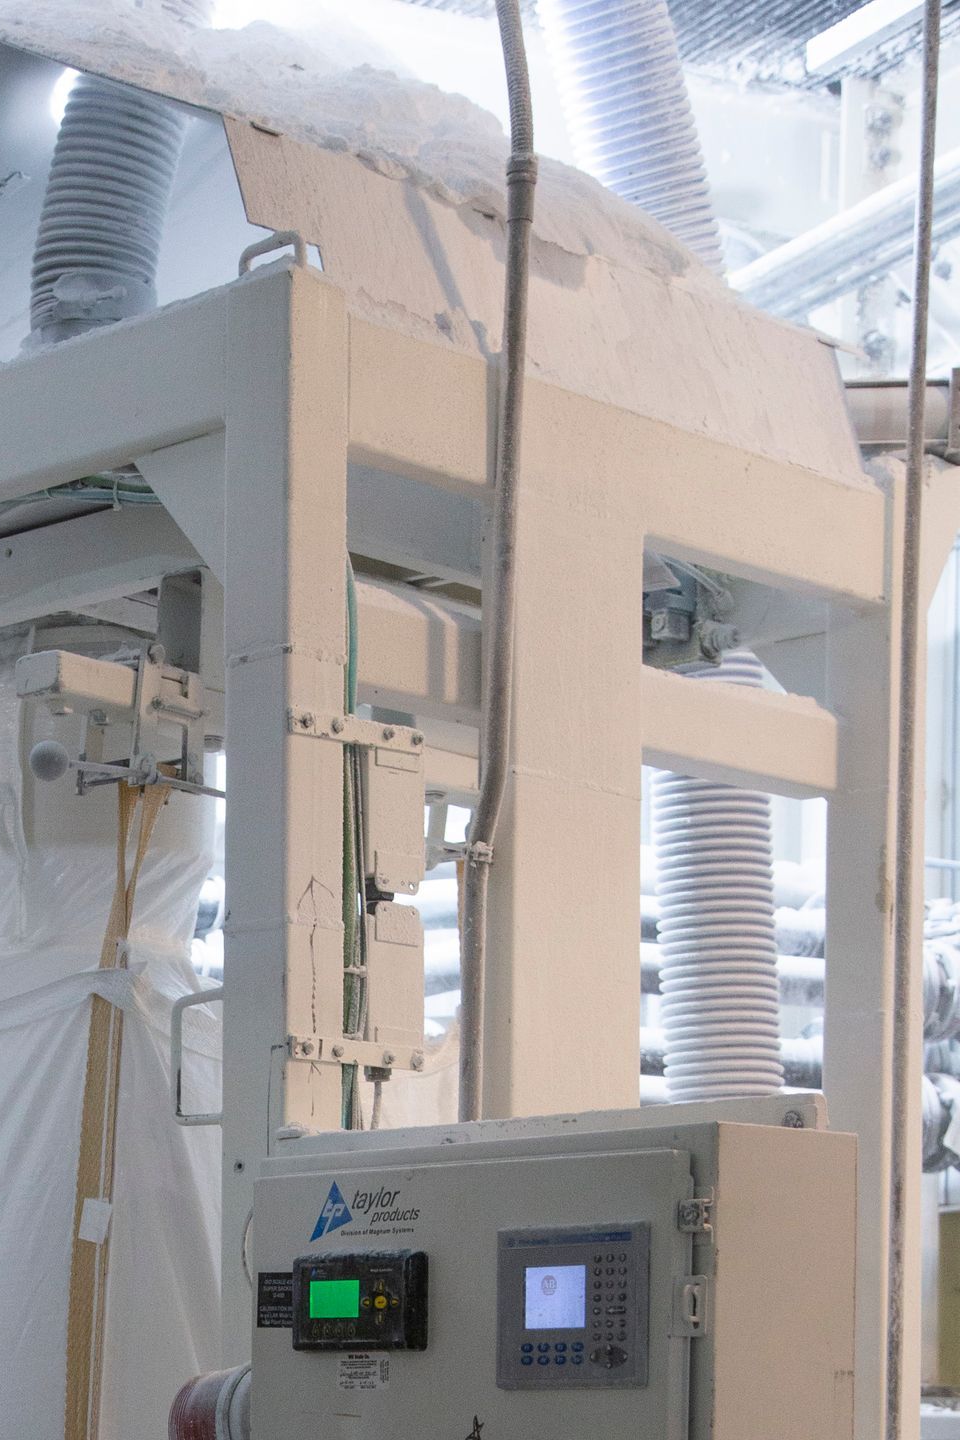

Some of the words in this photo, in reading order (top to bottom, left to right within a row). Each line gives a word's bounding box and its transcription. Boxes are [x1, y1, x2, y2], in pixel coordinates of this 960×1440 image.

[351, 1186, 401, 1214] taylor
[370, 1207, 420, 1225] products
[340, 1229, 362, 1237] Division
[391, 1226, 415, 1235] Systems
